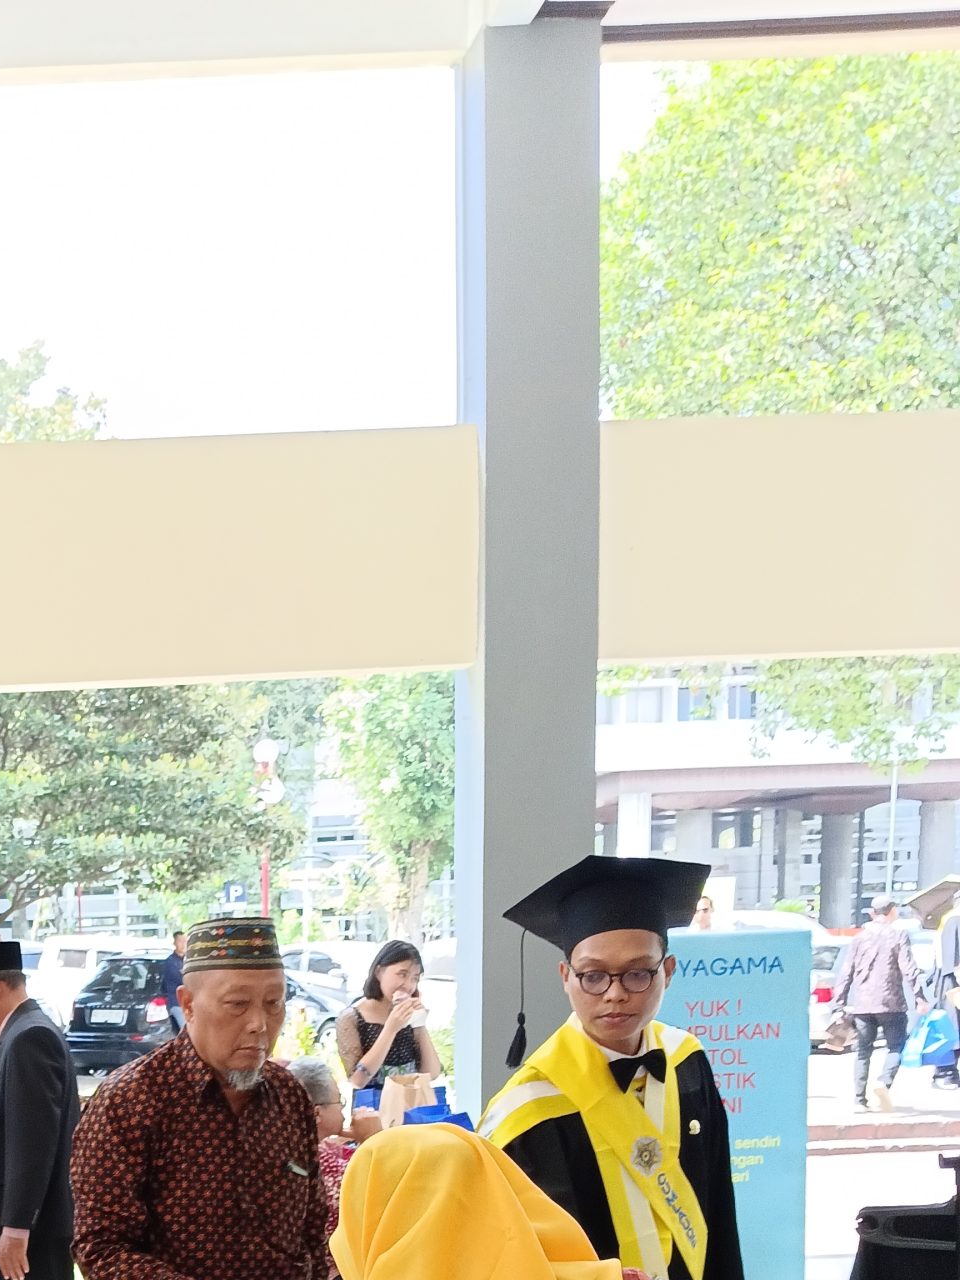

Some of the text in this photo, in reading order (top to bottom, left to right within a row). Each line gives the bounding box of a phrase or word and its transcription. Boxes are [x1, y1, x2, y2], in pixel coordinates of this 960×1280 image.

[229, 885, 243, 902] P
[678, 956, 784, 977] YAGAMA
[685, 1000, 730, 1018] YUK
[688, 1022, 781, 1042] PULKAN
[708, 1049, 748, 1066] TOL
[713, 1072, 756, 1090] STIK
[730, 1155, 764, 1169] ngan
